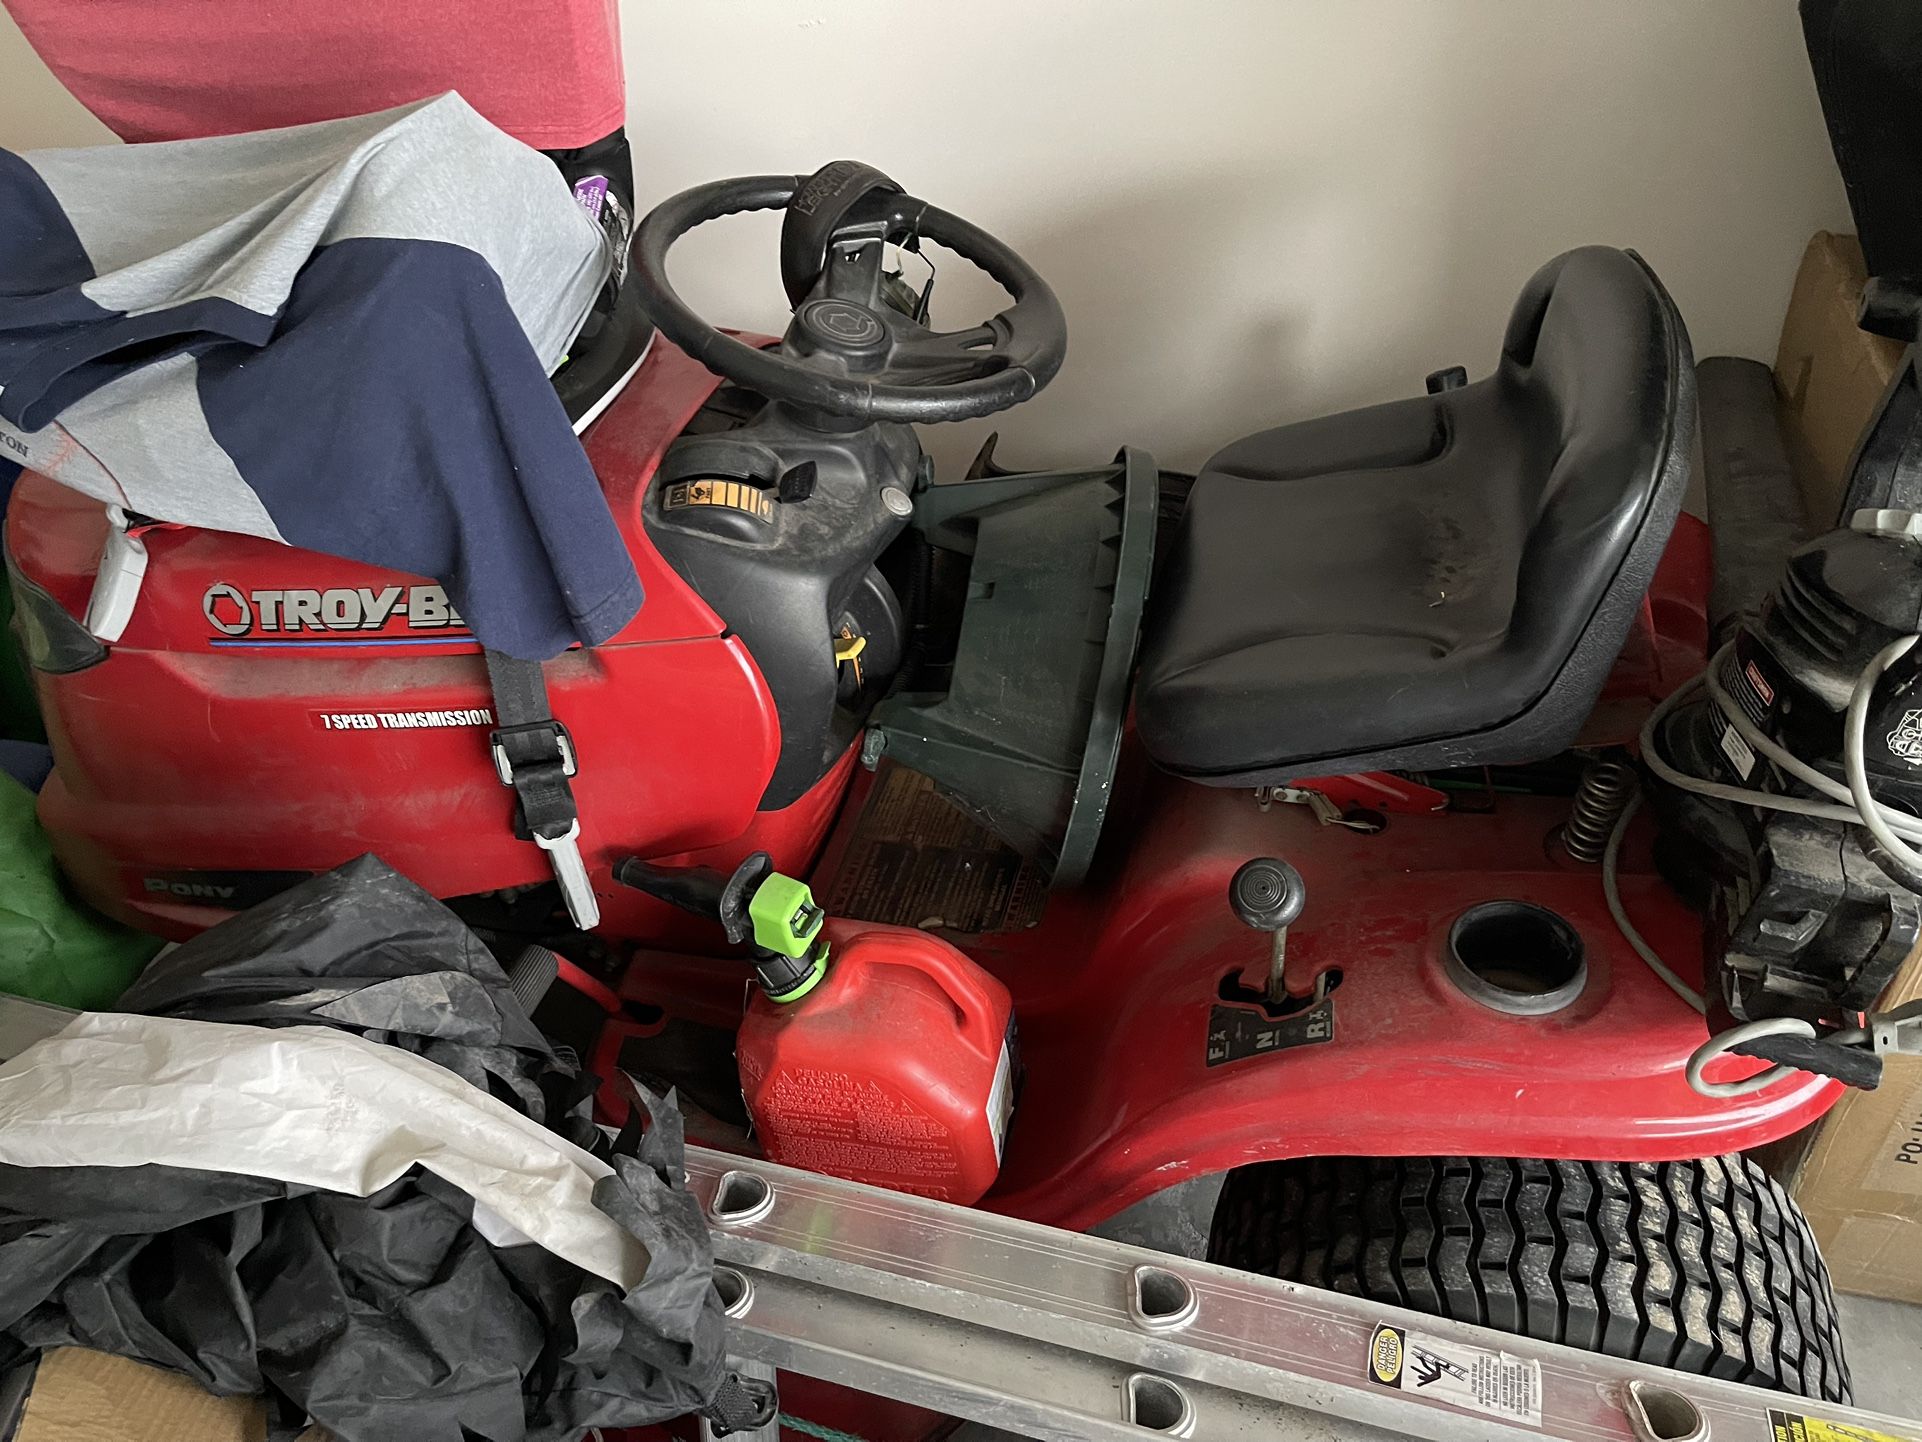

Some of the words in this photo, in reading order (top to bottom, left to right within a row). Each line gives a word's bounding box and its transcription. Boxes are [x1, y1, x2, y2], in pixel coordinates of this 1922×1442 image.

[252, 584, 465, 633] TROY-B
[320, 714, 333, 729] 7
[333, 713, 377, 730] SPEED
[377, 709, 493, 729] TRANSMISSION
[1306, 1022, 1325, 1039] R
[1256, 1031, 1273, 1049] N
[1208, 1047, 1224, 1060] F
[795, 1067, 849, 1083] PELIGRO
[798, 1076, 864, 1093] GASOLINA
[1377, 1336, 1388, 1369] DANGER
[1386, 1337, 1399, 1374] PELIGRO
